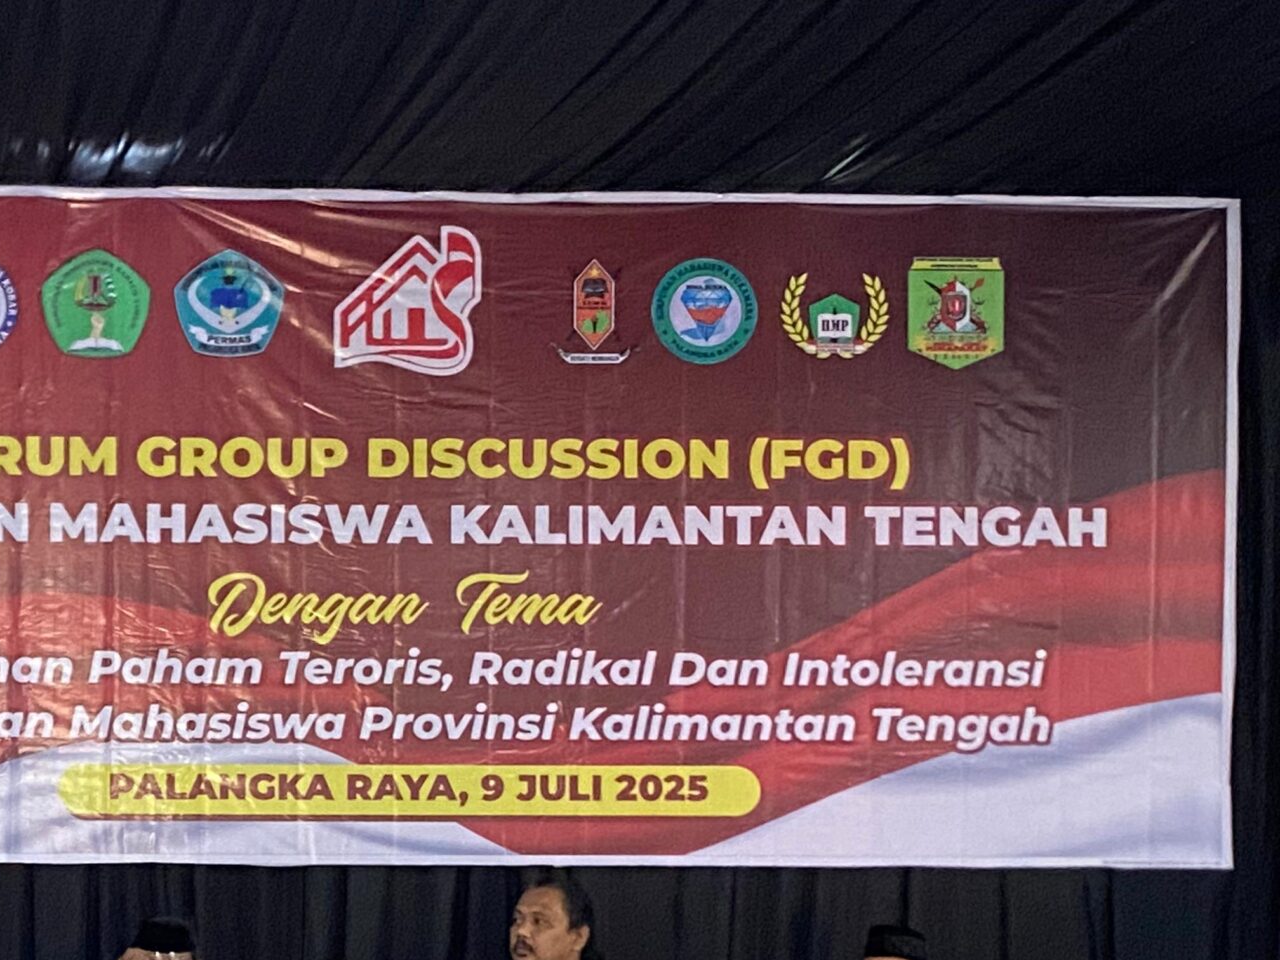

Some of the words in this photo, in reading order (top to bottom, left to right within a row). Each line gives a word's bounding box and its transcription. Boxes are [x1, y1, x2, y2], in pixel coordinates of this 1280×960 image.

[207, 334, 252, 345] PERMAS
[136, 436, 349, 479] GROUP
[367, 438, 729, 480] DISCUSSION
[749, 437, 910, 490] (FGD)
[49, 503, 433, 545] MAHASISWA
[450, 504, 847, 546] KALIMANTAN
[865, 506, 1108, 548] TENGAH
[208, 571, 429, 645] Dengan
[456, 569, 602, 635] Tema
[88, 649, 263, 686] Paham
[279, 647, 454, 693] Teroris,
[468, 650, 657, 687] Radikal
[668, 652, 769, 687] Dan
[782, 649, 1048, 688] Intoleransi
[70, 701, 345, 741] Mahasiswa
[359, 702, 555, 742] Provinsi
[569, 703, 855, 743] Kalimantan
[872, 707, 1053, 752] Tengah
[109, 772, 333, 803] PALANGKA
[346, 774, 469, 807] RAYA,
[481, 774, 502, 801] 9
[517, 774, 603, 802] JULI
[622, 774, 709, 802] 2025
